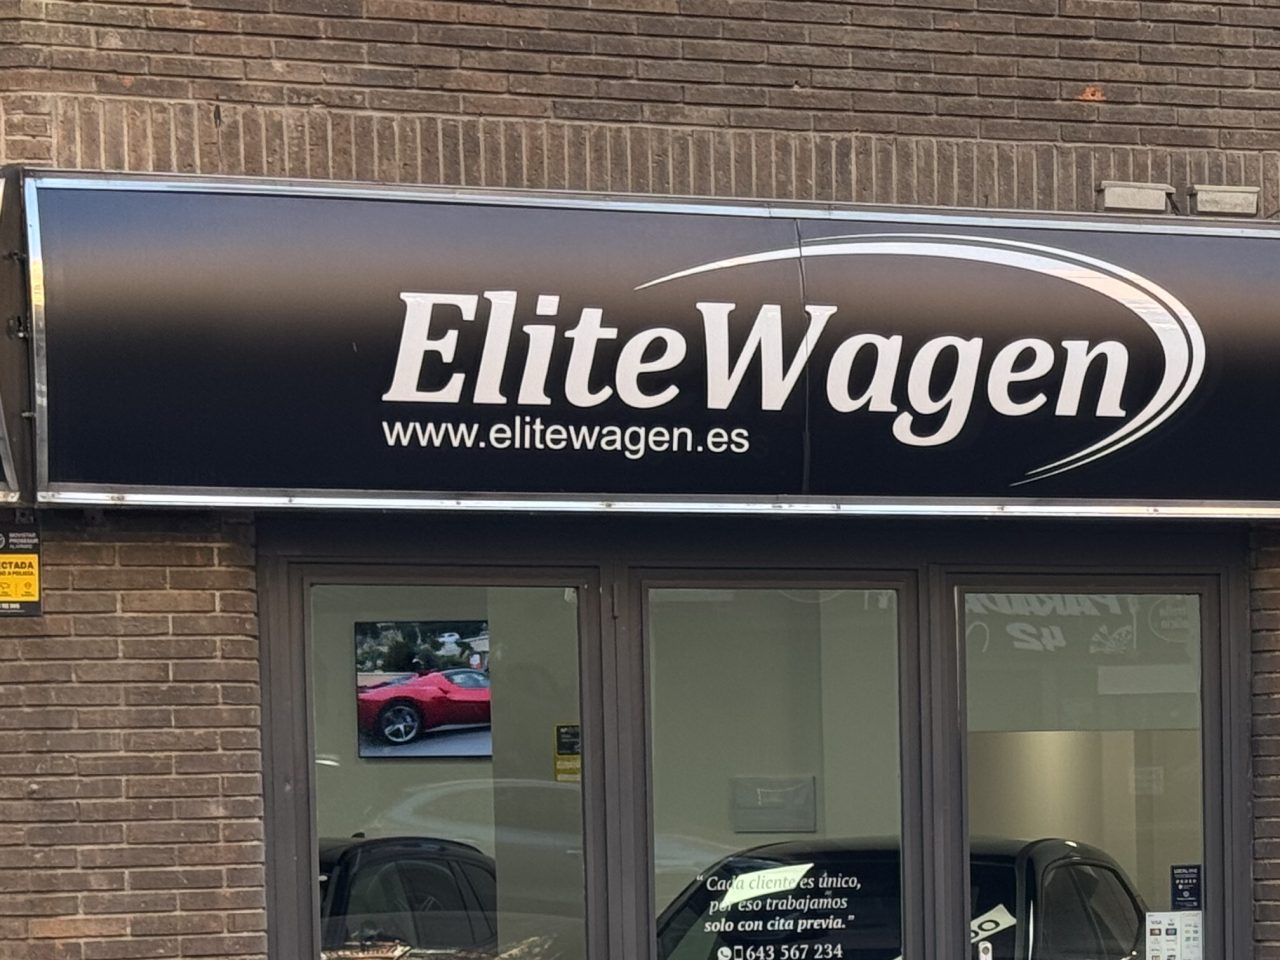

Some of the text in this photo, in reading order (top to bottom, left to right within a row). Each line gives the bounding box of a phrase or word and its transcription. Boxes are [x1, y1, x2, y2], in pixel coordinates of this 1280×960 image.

[382, 290, 1128, 447] EliteWagen
[382, 416, 750, 459] www.elitewagen.es
[0, 561, 34, 570] CTADA
[749, 875, 796, 890] cliente
[800, 876, 815, 889] es
[818, 872, 861, 890] único,
[709, 894, 848, 915] por eso trabajamos
[704, 917, 734, 932] solo
[738, 920, 763, 931] con
[767, 916, 794, 931] cita
[746, 943, 843, 960] 643 567 234
